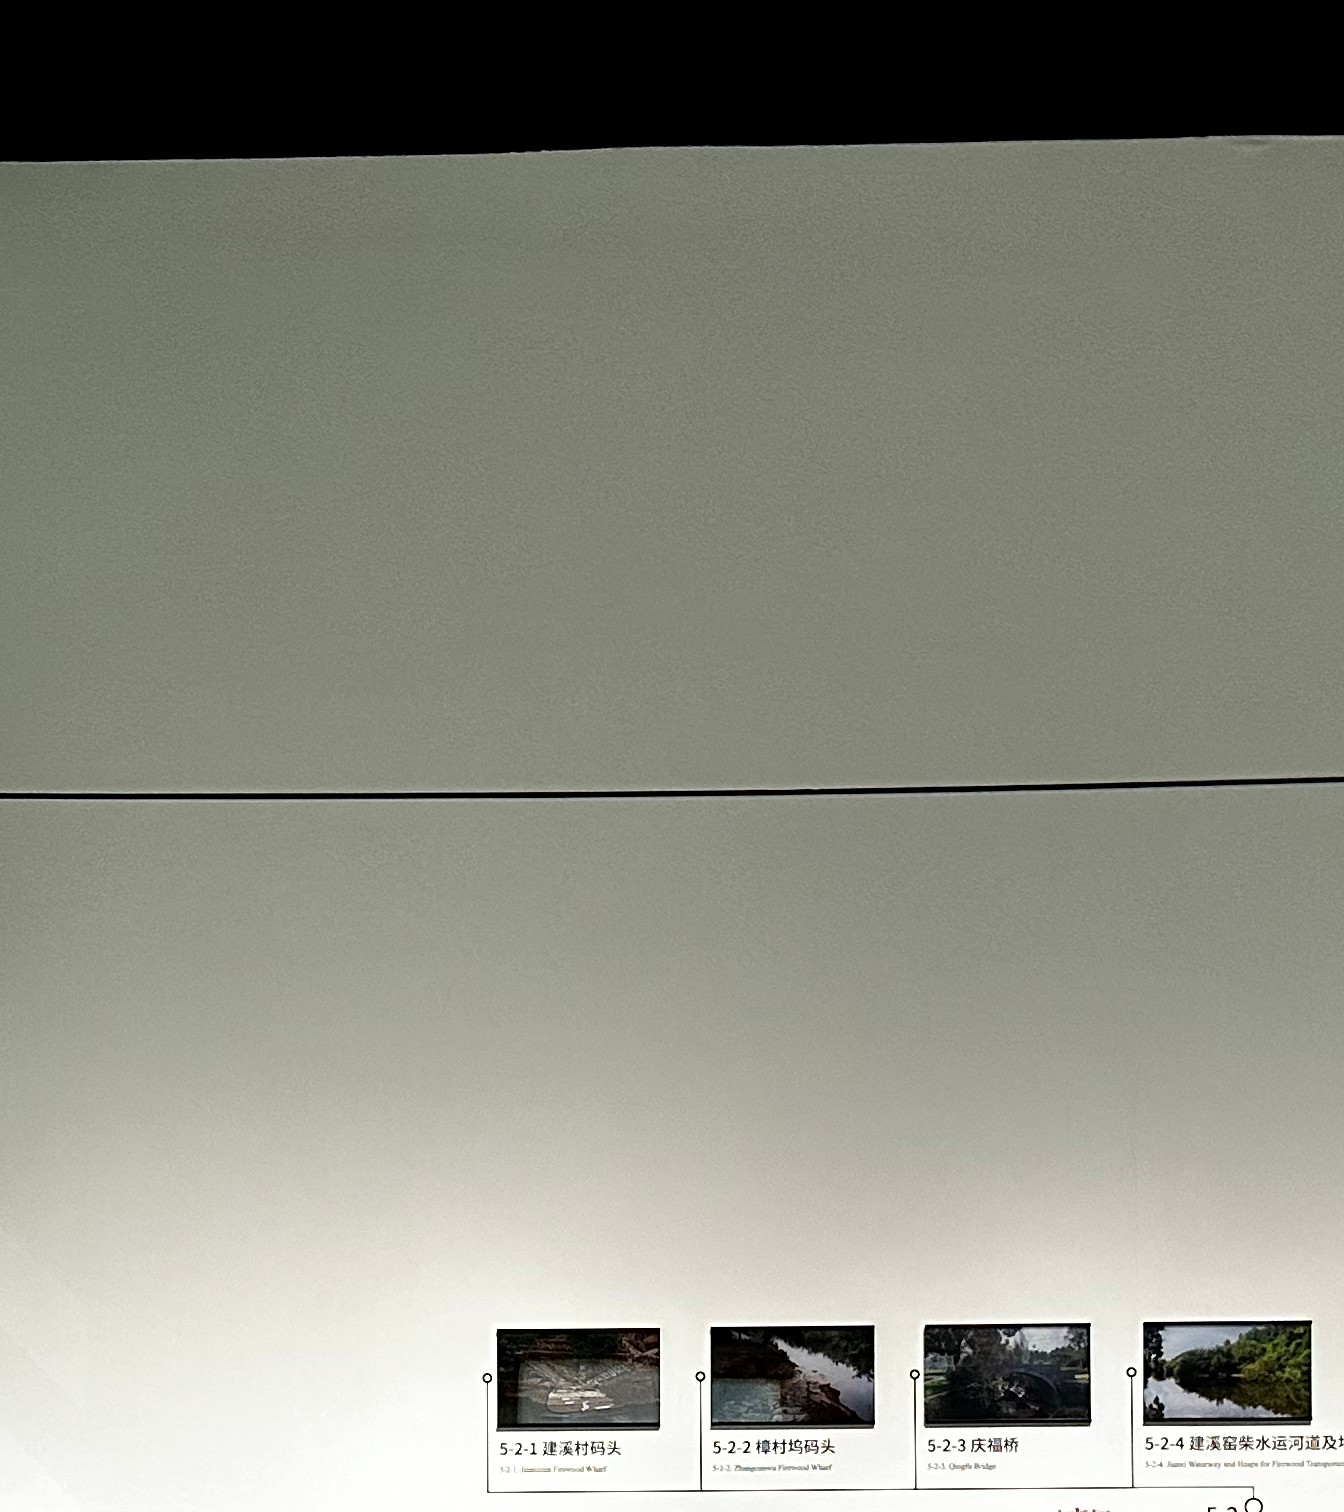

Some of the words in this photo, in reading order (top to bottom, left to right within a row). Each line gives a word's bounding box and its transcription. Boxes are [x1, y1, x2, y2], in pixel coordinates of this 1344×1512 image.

[499, 1442, 538, 1456] 5-2-1
[543, 1440, 622, 1456] 建溪村码头
[712, 1440, 751, 1454] 5-2-2
[756, 1438, 836, 1455] 樟村坞码头
[927, 1438, 966, 1453] 5-2-3
[970, 1437, 1019, 1453] 庆福桥
[1145, 1436, 1184, 1451] 5-2-4
